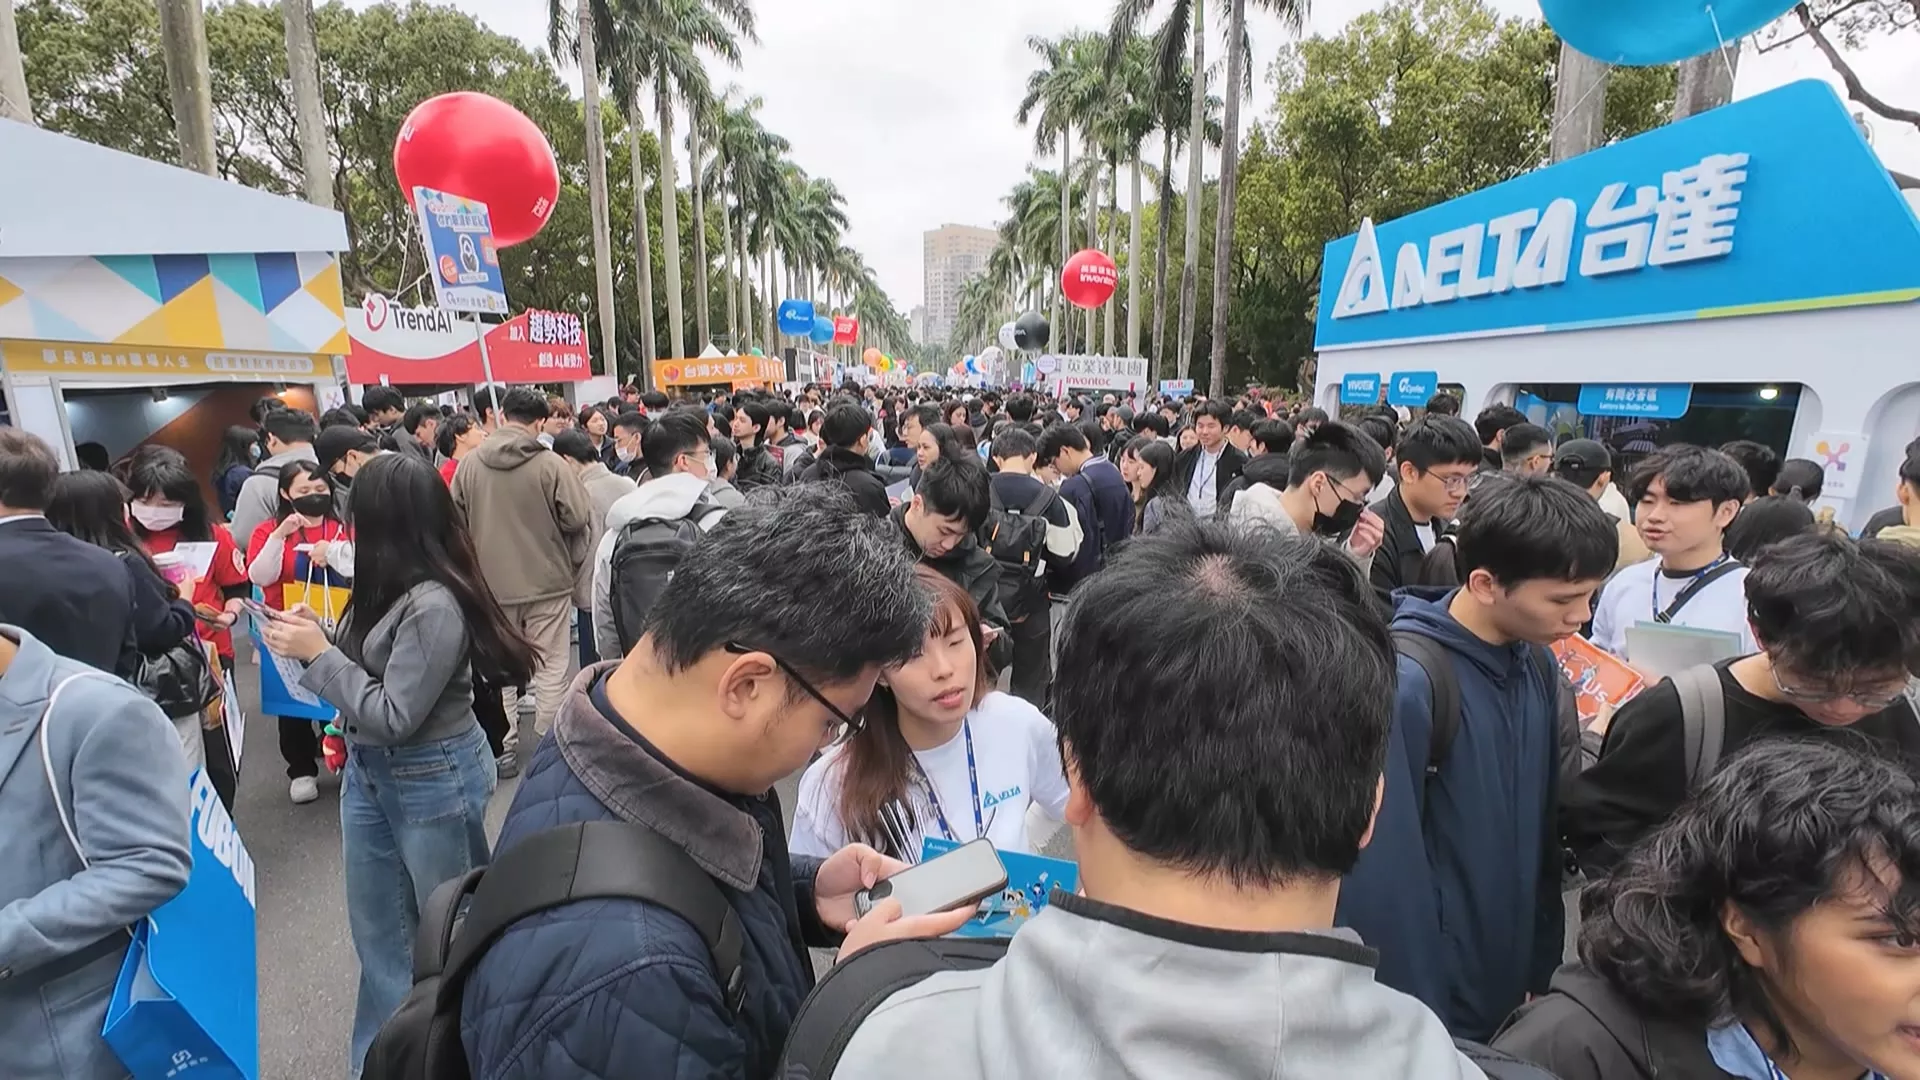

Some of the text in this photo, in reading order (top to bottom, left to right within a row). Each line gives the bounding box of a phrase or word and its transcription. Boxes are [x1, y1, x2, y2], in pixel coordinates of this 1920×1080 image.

[1391, 153, 1750, 310] DELTA 台達
[390, 304, 452, 334] TrendAI
[510, 309, 582, 346] 加入 趨勢科技
[684, 362, 748, 378] 台灣大哥大
[1067, 358, 1142, 376] 英業達集團
[1582, 677, 1608, 703] Us
